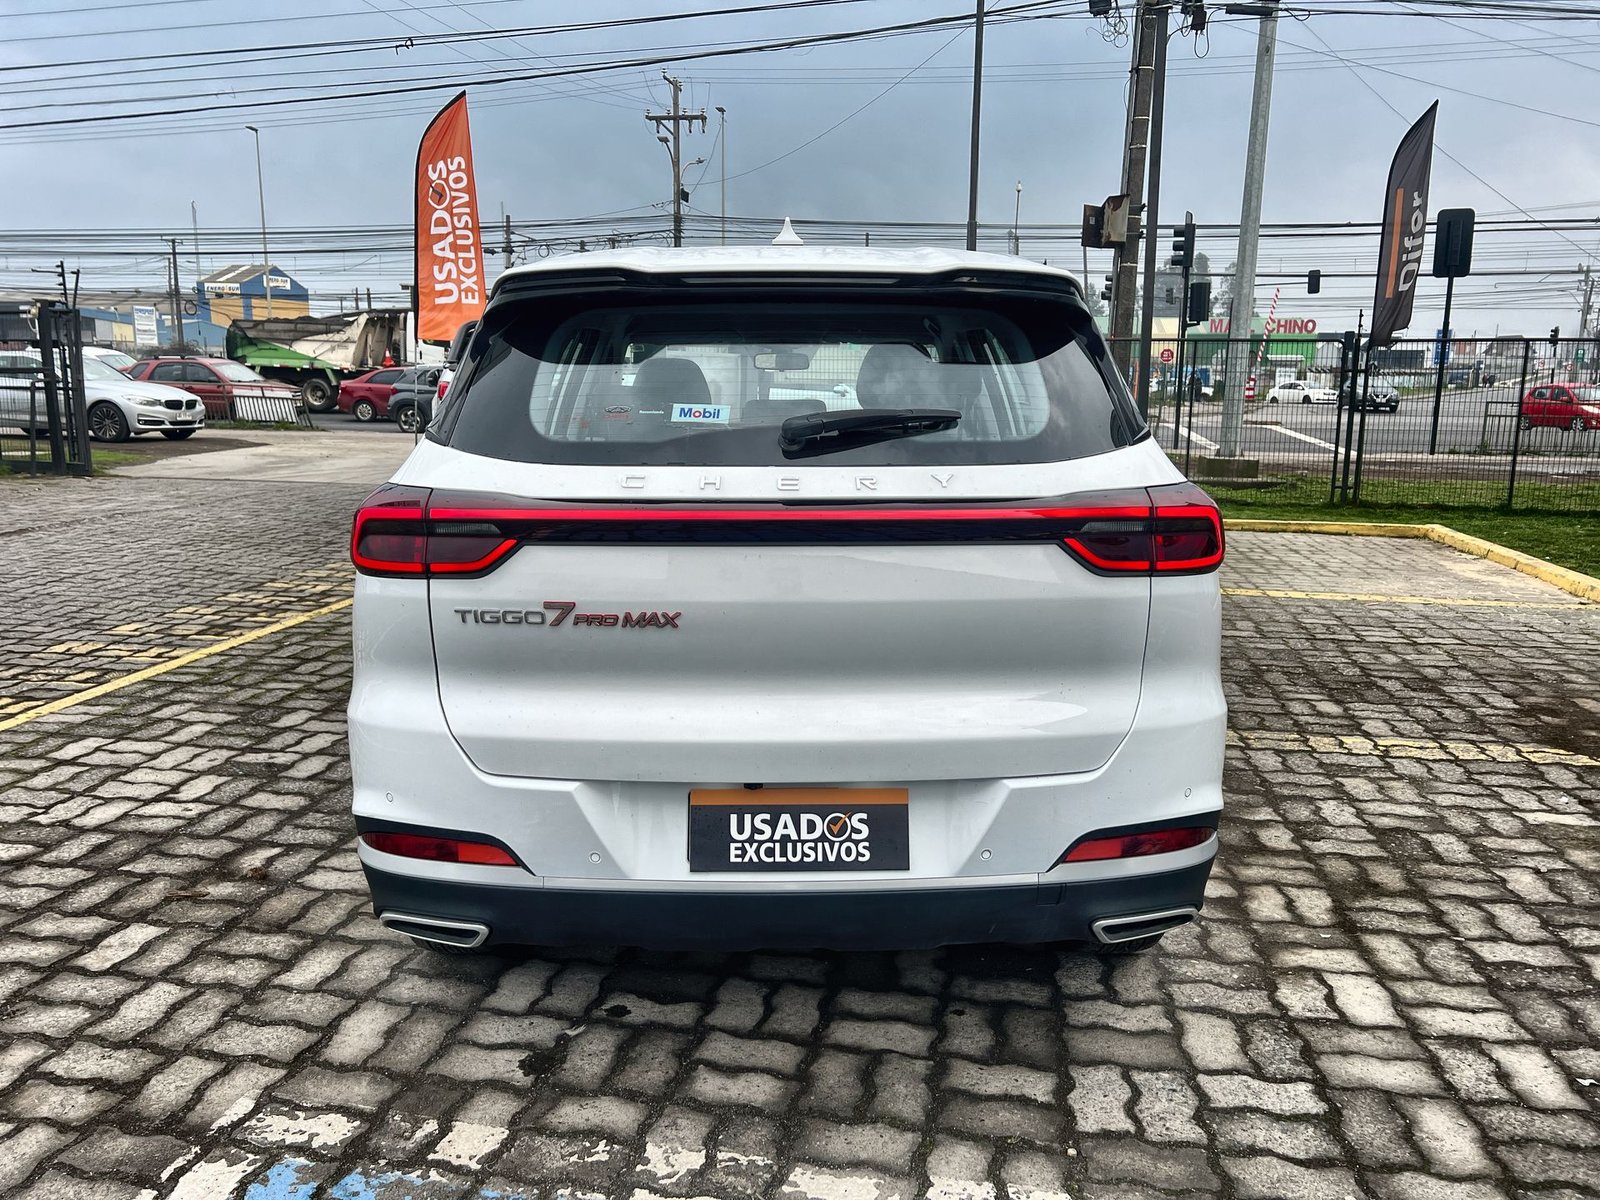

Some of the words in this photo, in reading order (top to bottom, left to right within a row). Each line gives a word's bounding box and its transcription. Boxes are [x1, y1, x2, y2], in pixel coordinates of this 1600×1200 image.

[428, 160, 458, 305] USADOS
[448, 156, 479, 305] EXCLUSIVOS
[1399, 191, 1423, 291] Difor
[1266, 318, 1317, 334] CHINO
[678, 407, 721, 419] Mobil
[620, 473, 954, 491] CHERY
[454, 608, 546, 625] TIGGO
[543, 601, 576, 626] 7
[573, 613, 619, 626] PRO
[621, 612, 682, 628] MAX
[729, 811, 870, 842] USADOS
[729, 841, 871, 863] EXCLUSIVOS
